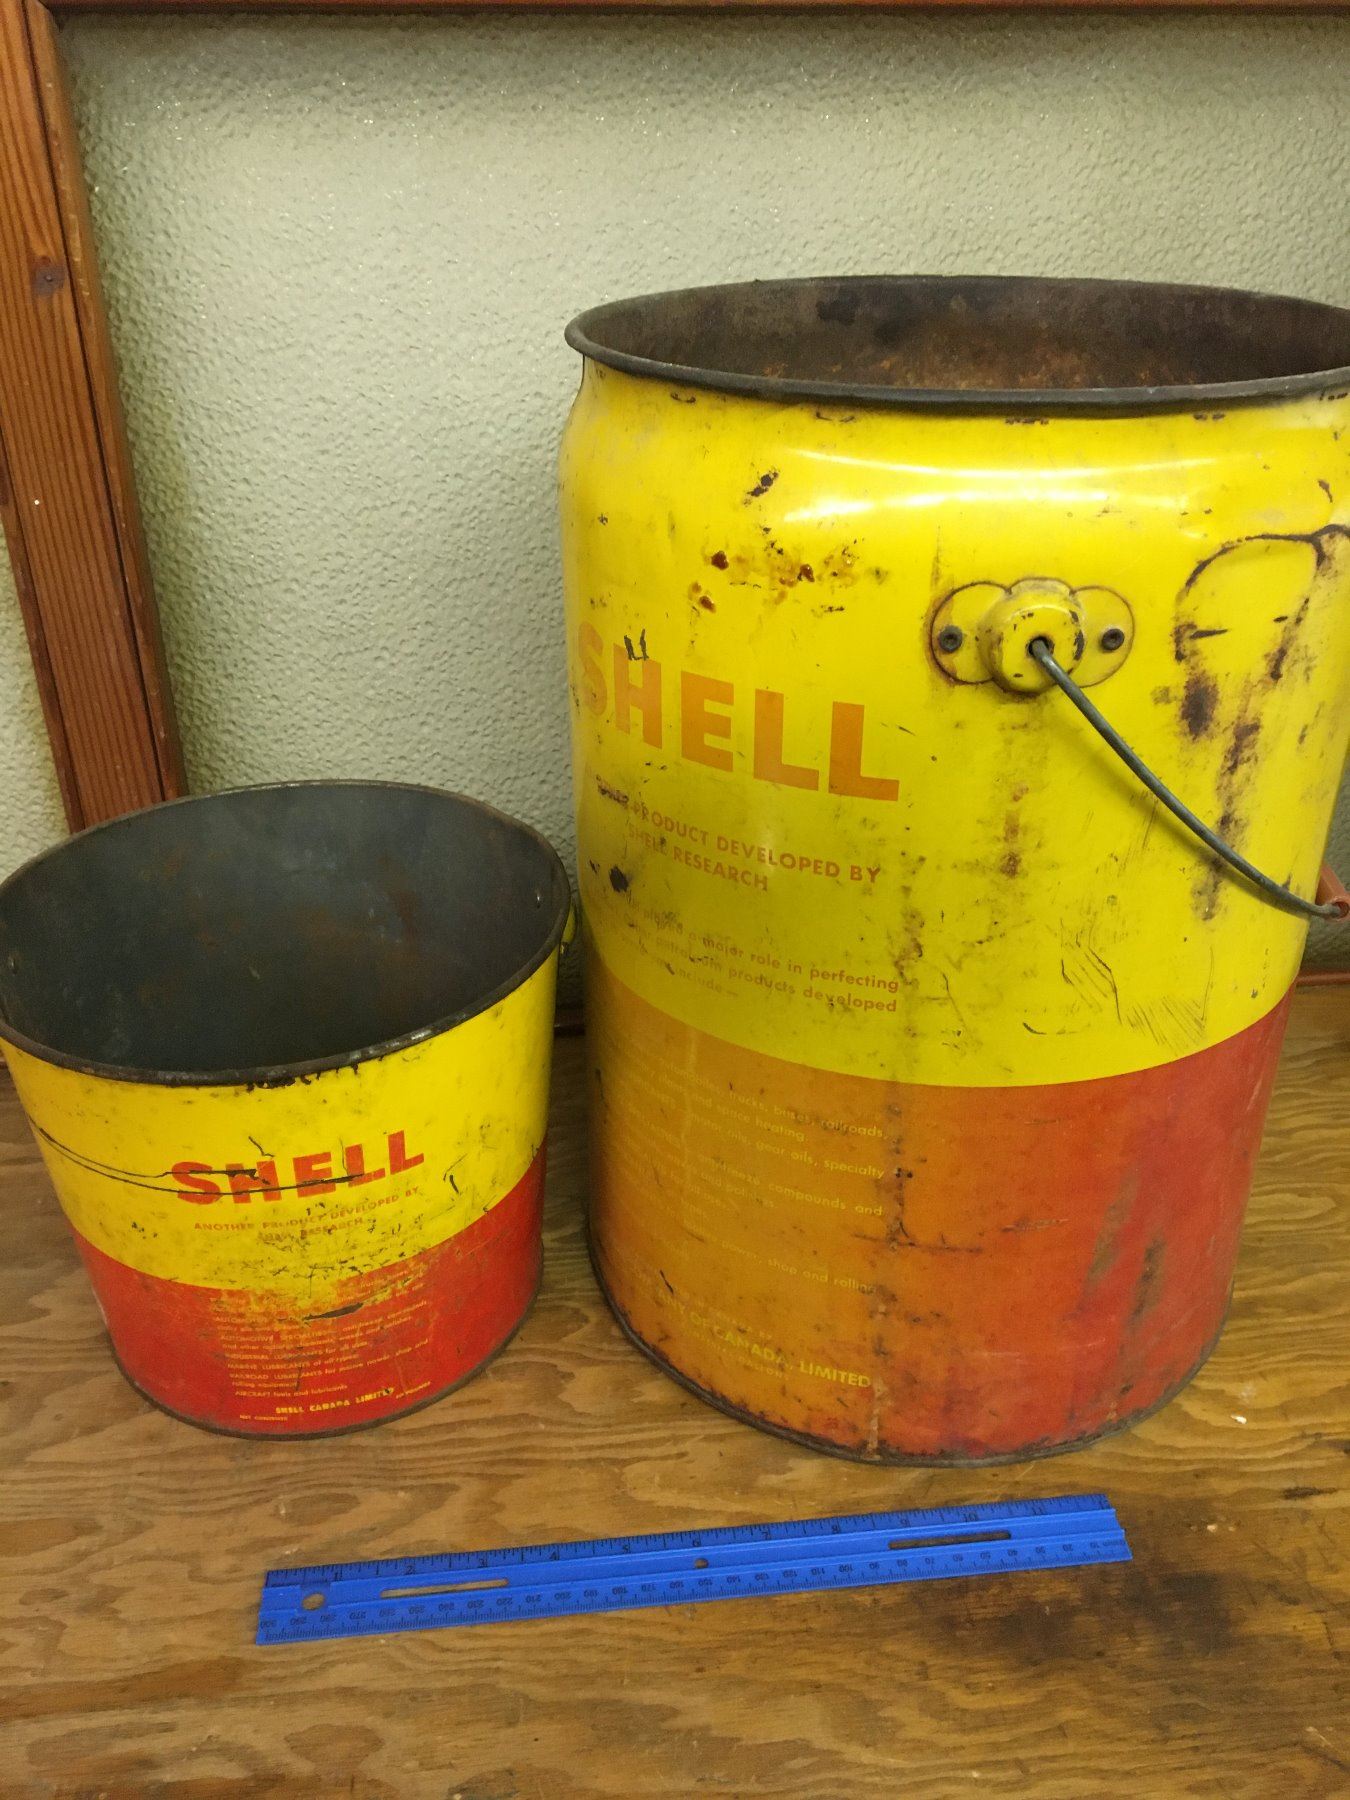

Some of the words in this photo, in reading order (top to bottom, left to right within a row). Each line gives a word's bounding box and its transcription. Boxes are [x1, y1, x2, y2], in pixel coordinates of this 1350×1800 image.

[577, 620, 899, 801] SHELL
[630, 801, 709, 846] PRODUCT
[717, 835, 840, 878] DEVELOPED
[850, 864, 880, 883] BY
[673, 846, 768, 892] RESEARCH
[702, 936, 744, 958] major
[751, 953, 781, 969] role
[787, 959, 802, 974] in
[809, 967, 899, 994] perfecting
[728, 967, 796, 994] products
[803, 986, 897, 1012] developed
[171, 1130, 425, 1205] SHELL
[823, 1159, 885, 1180] specialty
[194, 1221, 255, 1232] ANOTHER
[330, 1195, 400, 1220] DEVELOPED
[405, 1186, 420, 1197] BY
[768, 1181, 847, 1210] compounds
[854, 1203, 884, 1217] and
[802, 1267, 829, 1283] and
[799, 1361, 872, 1388] LIMITED
[275, 1406, 304, 1414] SHELL
[309, 1399, 350, 1412] CANADA
